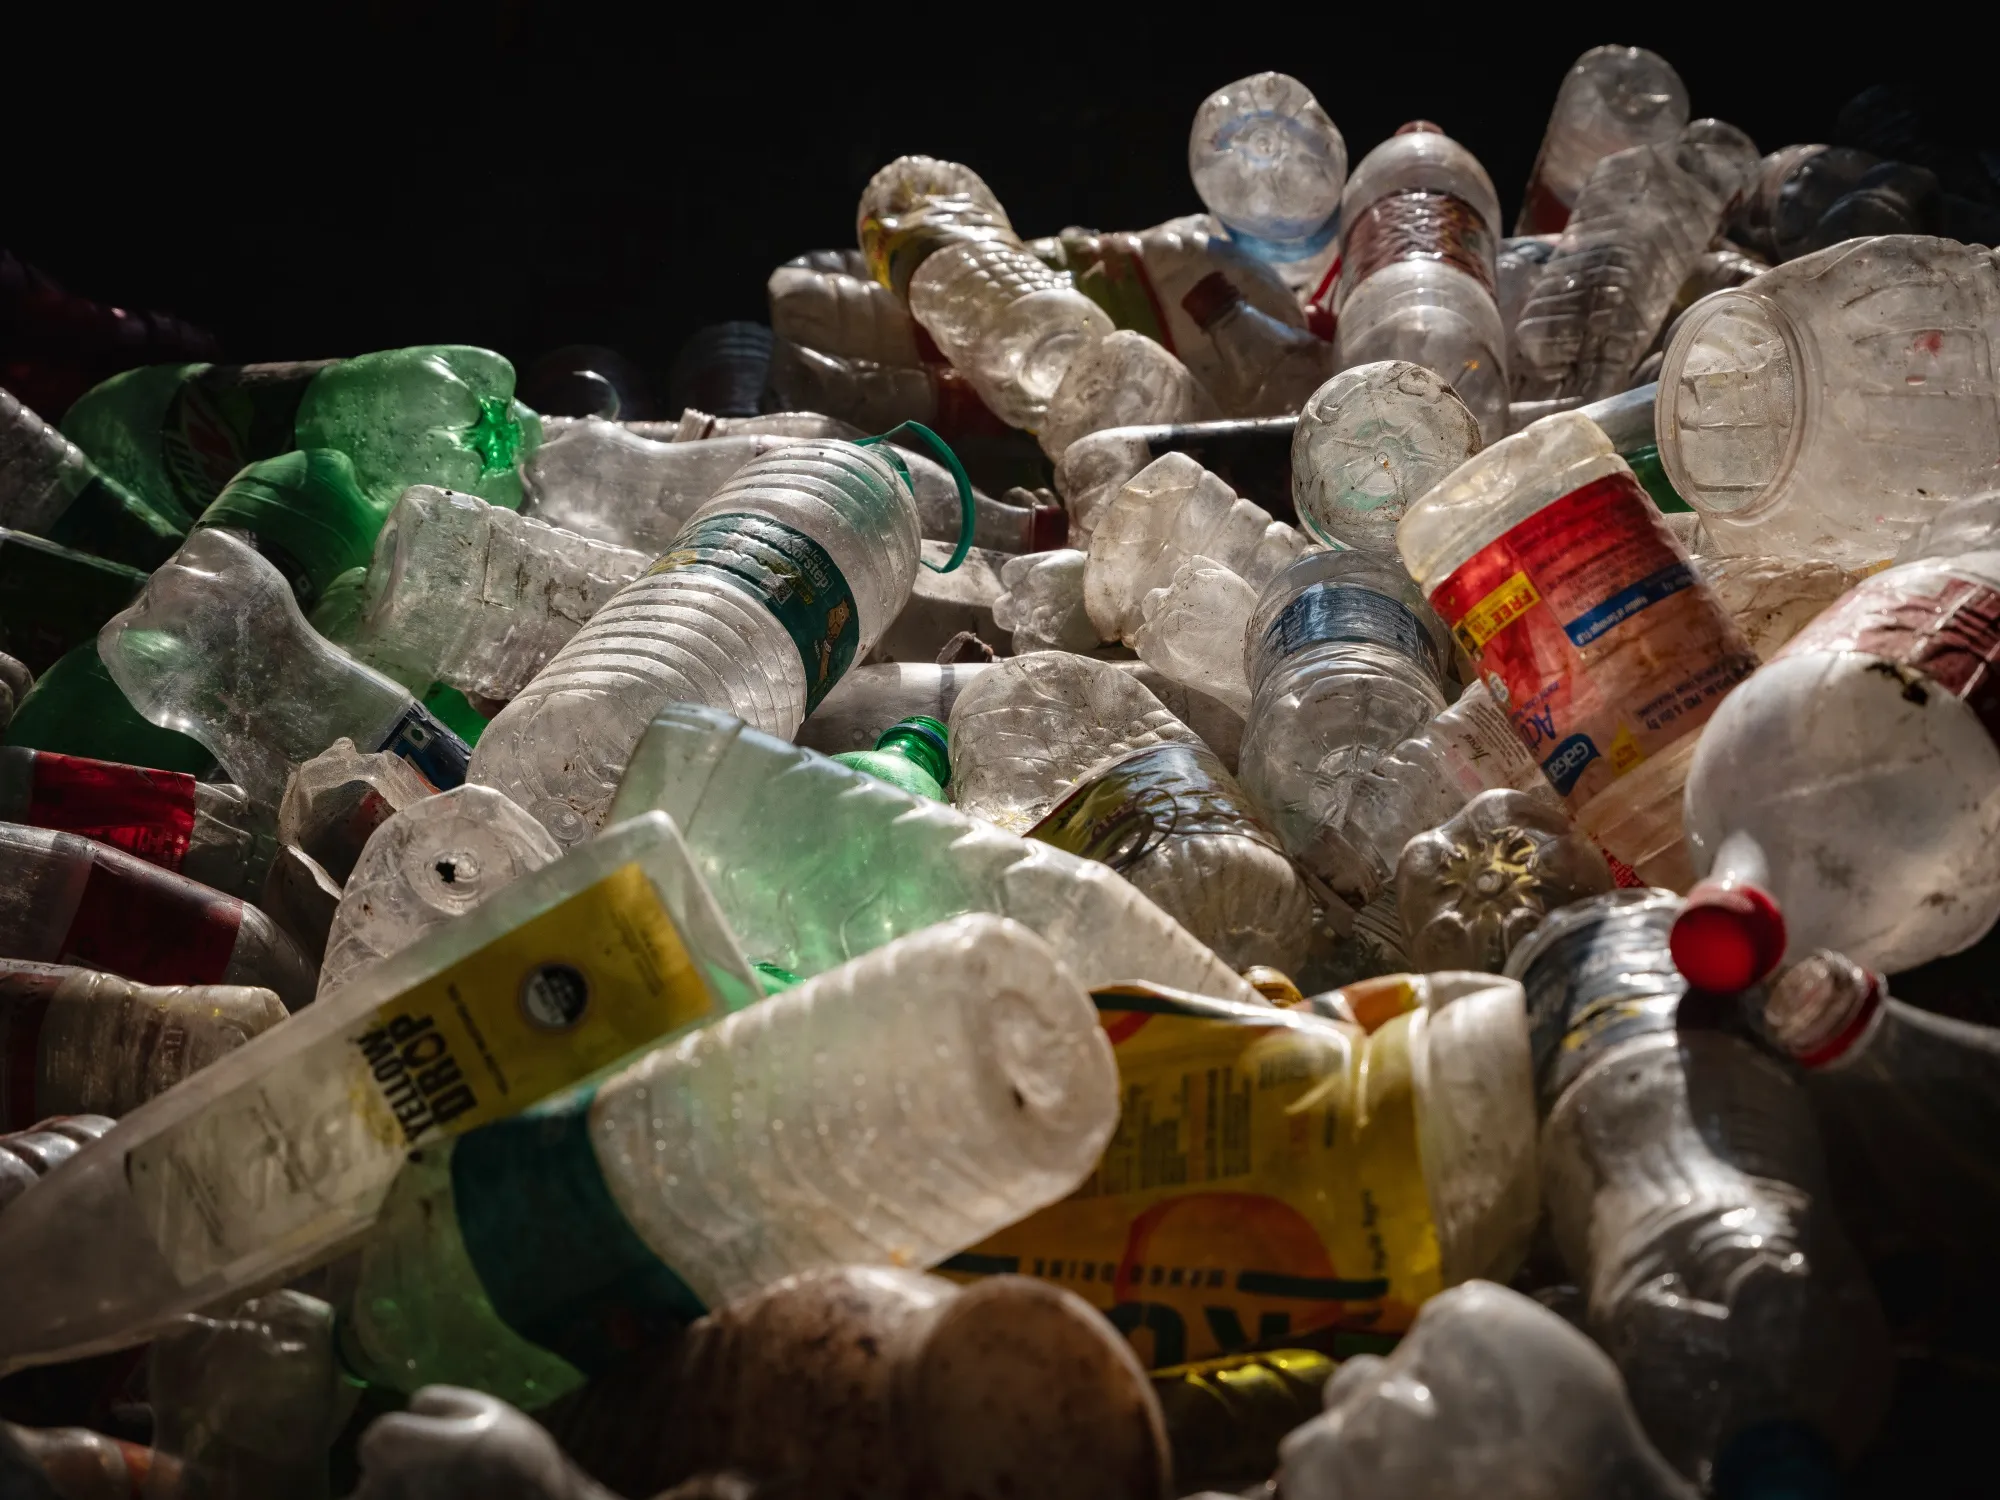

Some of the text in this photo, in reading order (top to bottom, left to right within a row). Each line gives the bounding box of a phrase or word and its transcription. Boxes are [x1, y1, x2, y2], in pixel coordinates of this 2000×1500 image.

[1490, 588, 1533, 625] FREE
[358, 1030, 435, 1142] YELLOW
[387, 1013, 478, 1123] DROP
